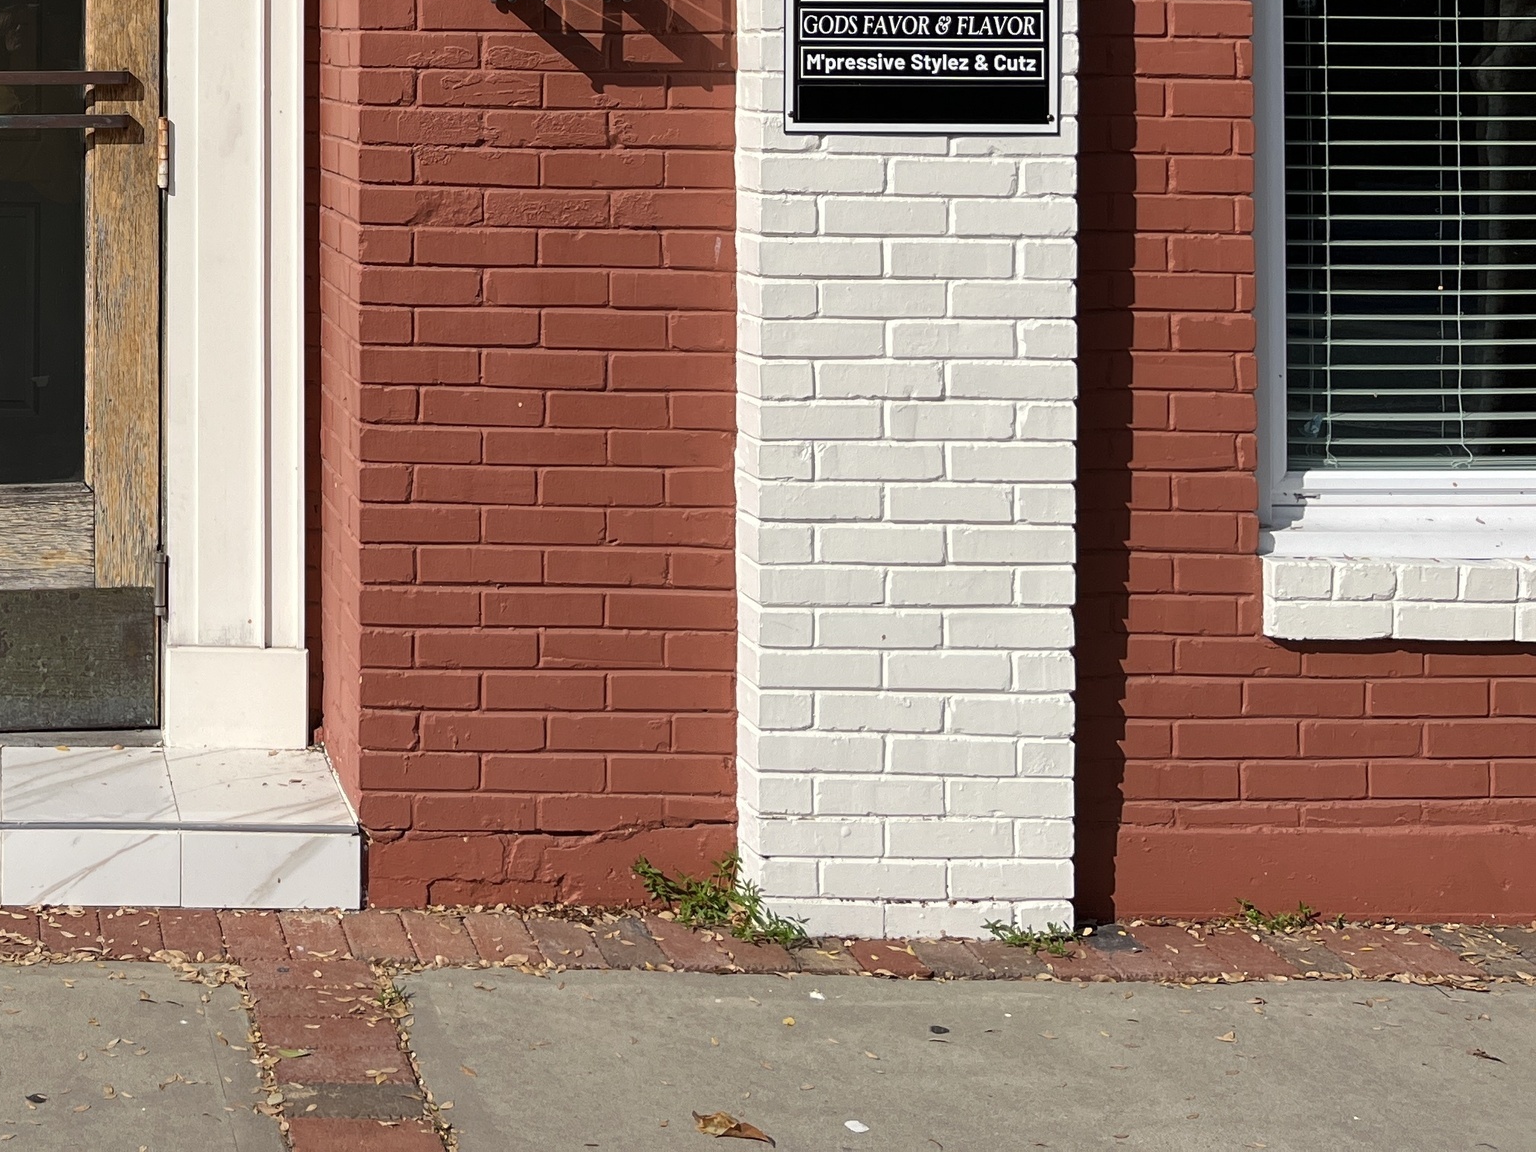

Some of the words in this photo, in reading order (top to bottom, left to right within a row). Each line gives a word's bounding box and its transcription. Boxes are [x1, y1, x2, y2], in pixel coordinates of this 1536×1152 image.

[804, 15, 858, 35] GODS
[863, 16, 930, 35] FAVOR
[935, 16, 951, 35] &
[957, 16, 1036, 36] FLAVOR
[806, 53, 906, 73] M'pressive
[911, 54, 969, 74] Stylez
[975, 54, 989, 71] &
[994, 55, 1037, 72] Cutz
